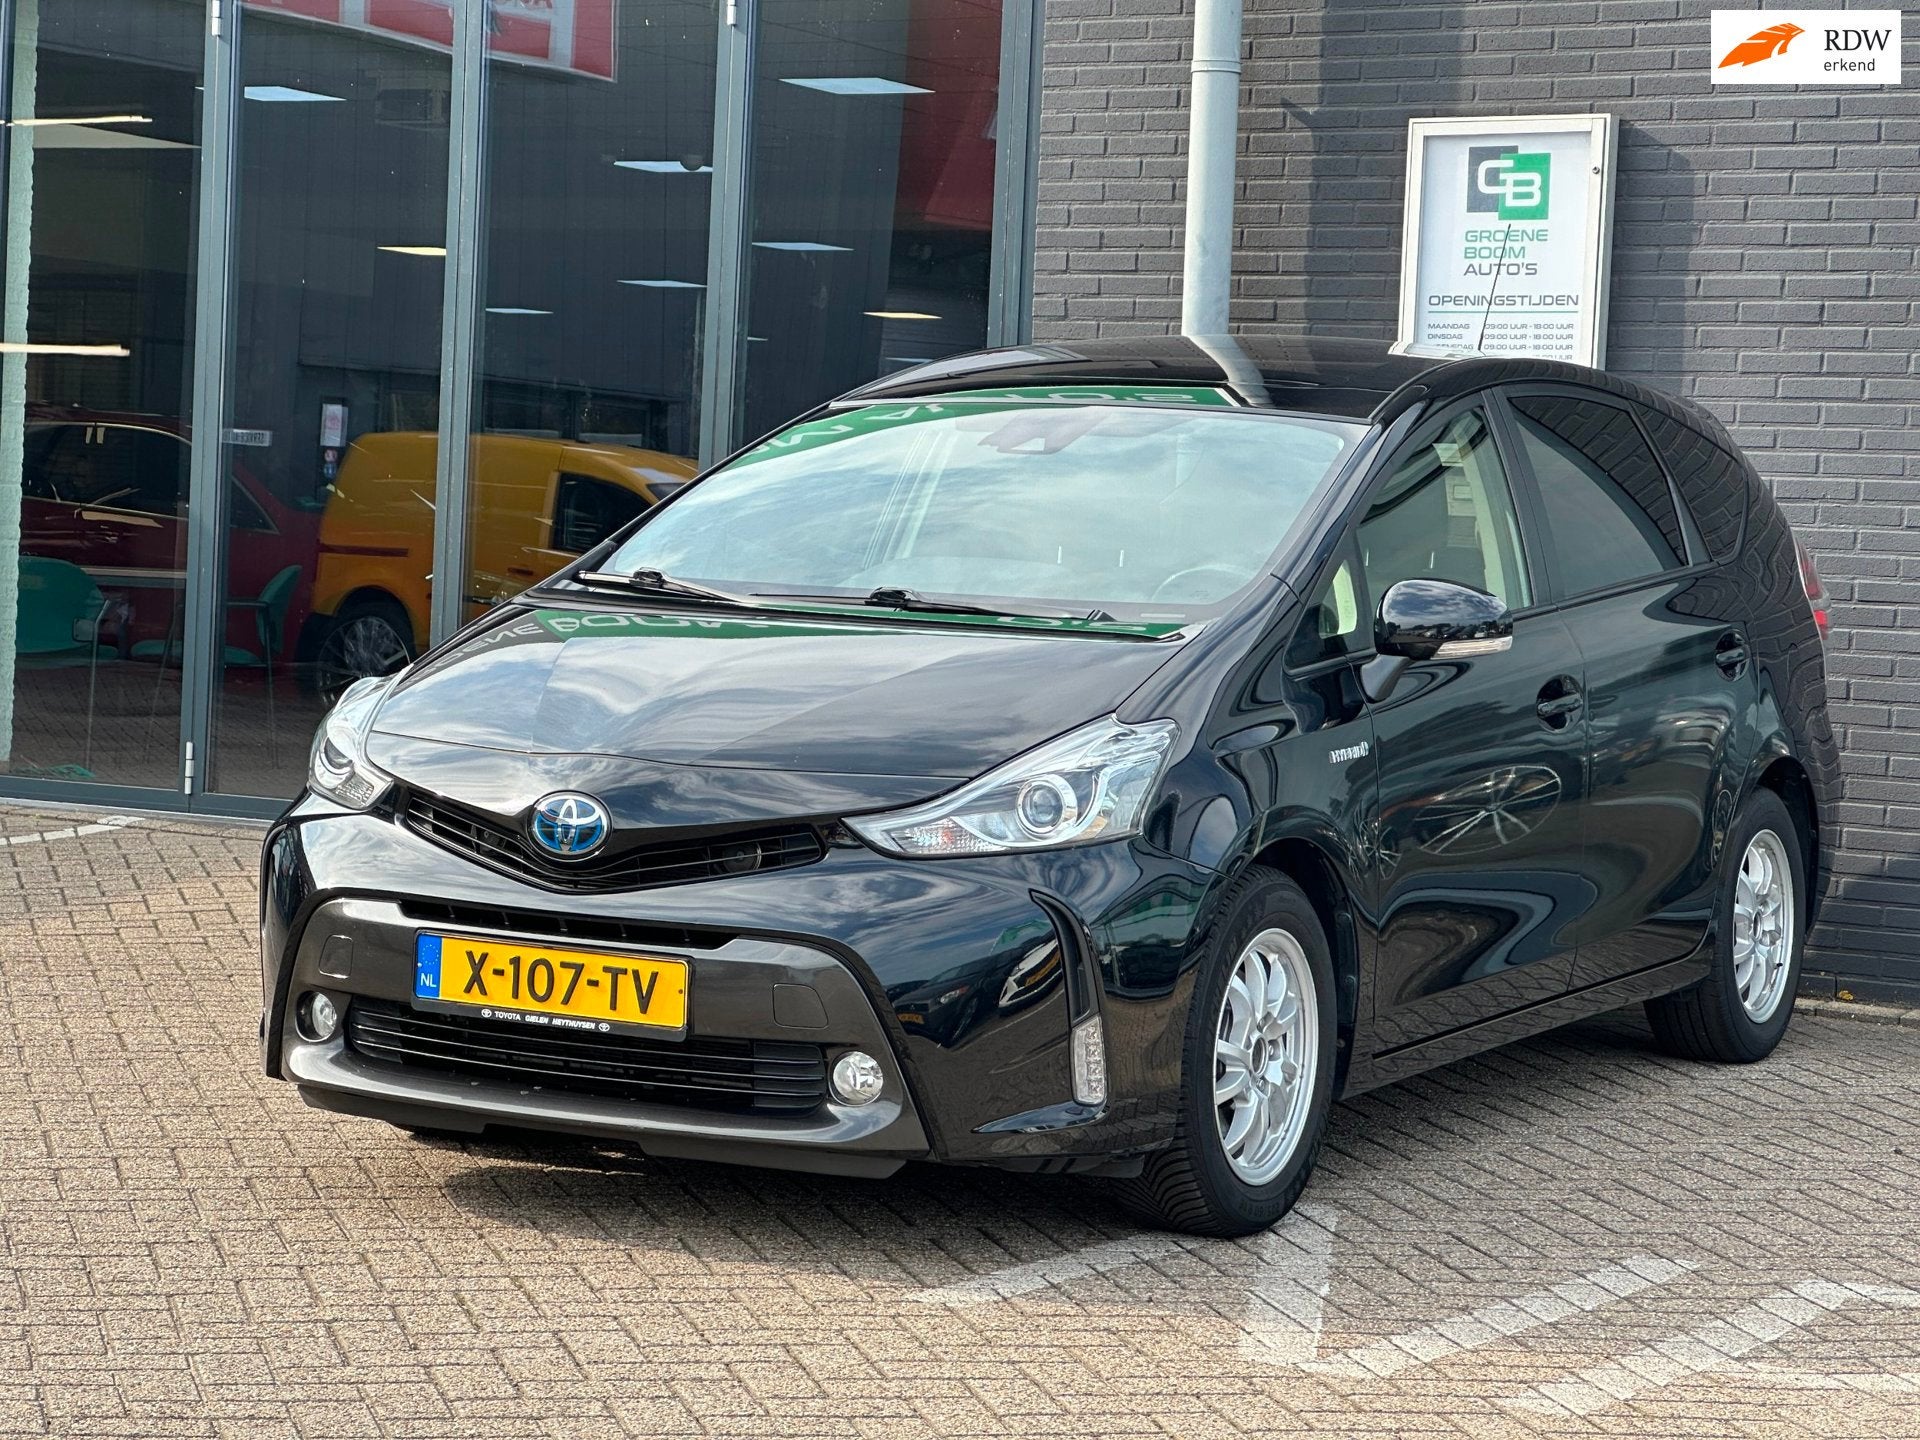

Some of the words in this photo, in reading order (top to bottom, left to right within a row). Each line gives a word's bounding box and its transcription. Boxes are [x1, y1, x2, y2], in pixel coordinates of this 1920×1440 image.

[1465, 229, 1548, 243] GROENE
[1464, 246, 1526, 259] BOOM
[1463, 262, 1538, 276] AUTO'S
[1428, 295, 1579, 306] OPENINGSTIJDEN
[420, 972, 437, 988] NL
[463, 950, 658, 1015] X-107-TV
[494, 1010, 521, 1021] TOYOTA
[525, 1014, 549, 1025] GIELEN
[552, 1017, 596, 1030] HEYTHUYSEN
